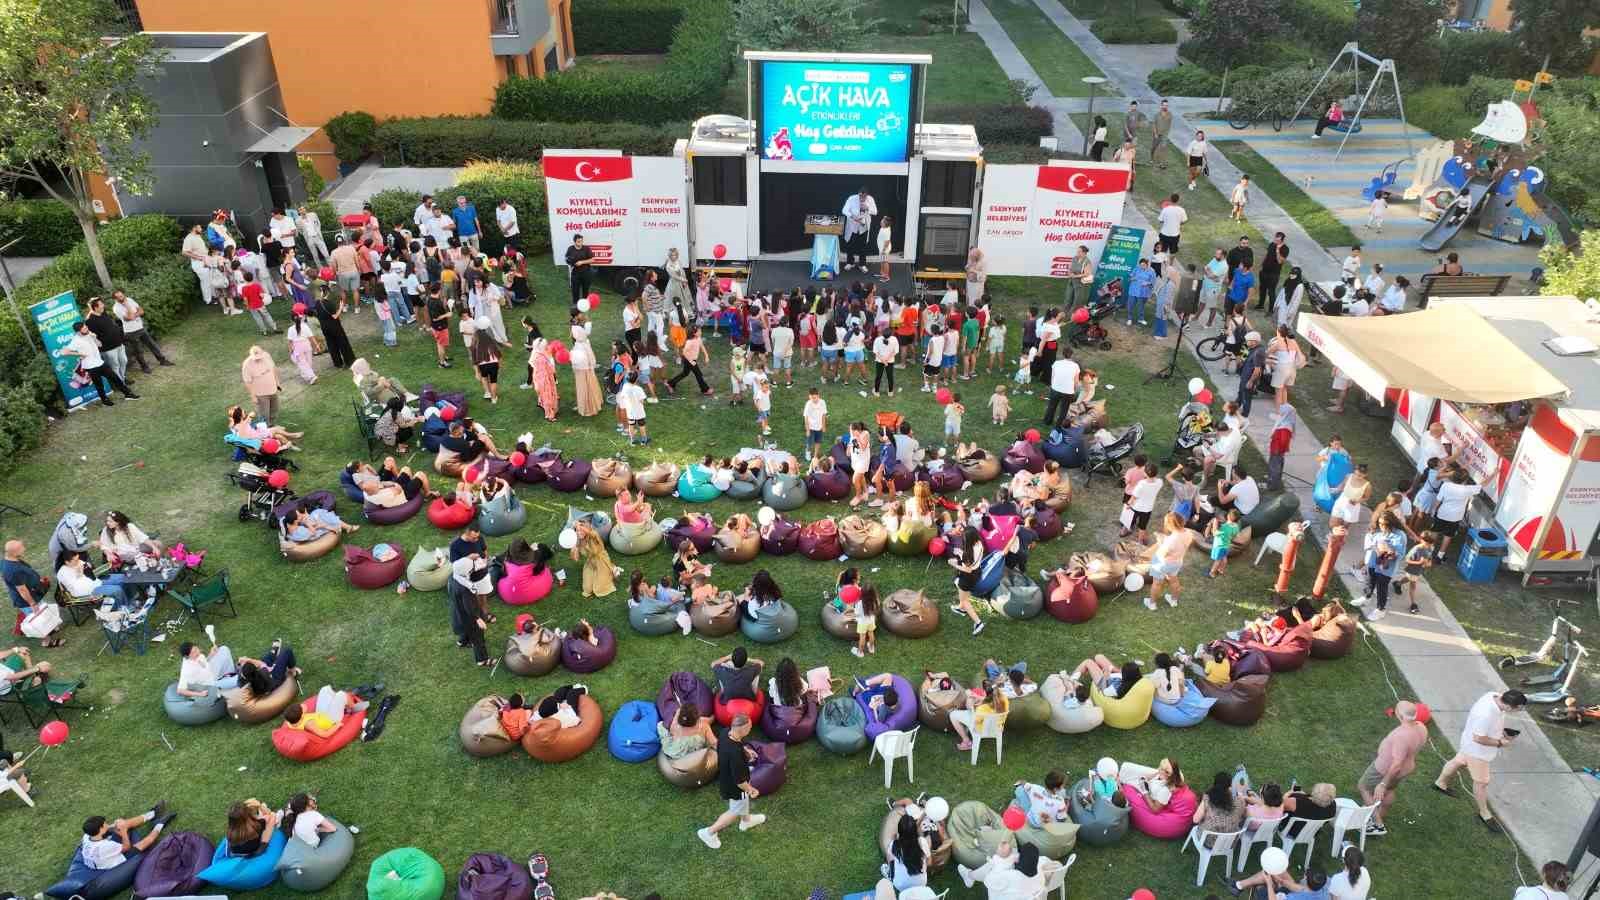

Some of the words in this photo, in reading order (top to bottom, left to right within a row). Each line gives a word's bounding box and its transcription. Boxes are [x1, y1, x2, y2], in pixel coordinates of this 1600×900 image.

[838, 87, 890, 108] HAVA
[822, 124, 877, 140] Geldiniz
[569, 196, 613, 206] KIYMETLİ
[556, 208, 628, 217] KOMŞULARIMIZ
[640, 206, 681, 214] BELEDİYESİ
[990, 205, 1027, 213] ESENYURT
[1055, 208, 1099, 219] KIYMETLİ
[986, 214, 1027, 222] BELEDİYESİ
[565, 222, 583, 232] Hoş
[585, 218, 621, 229] Geldiniz
[1040, 219, 1112, 230] KOMŞULARIMIZ
[1044, 232, 1062, 242] Hoş
[1065, 231, 1103, 241] Geldiniz
